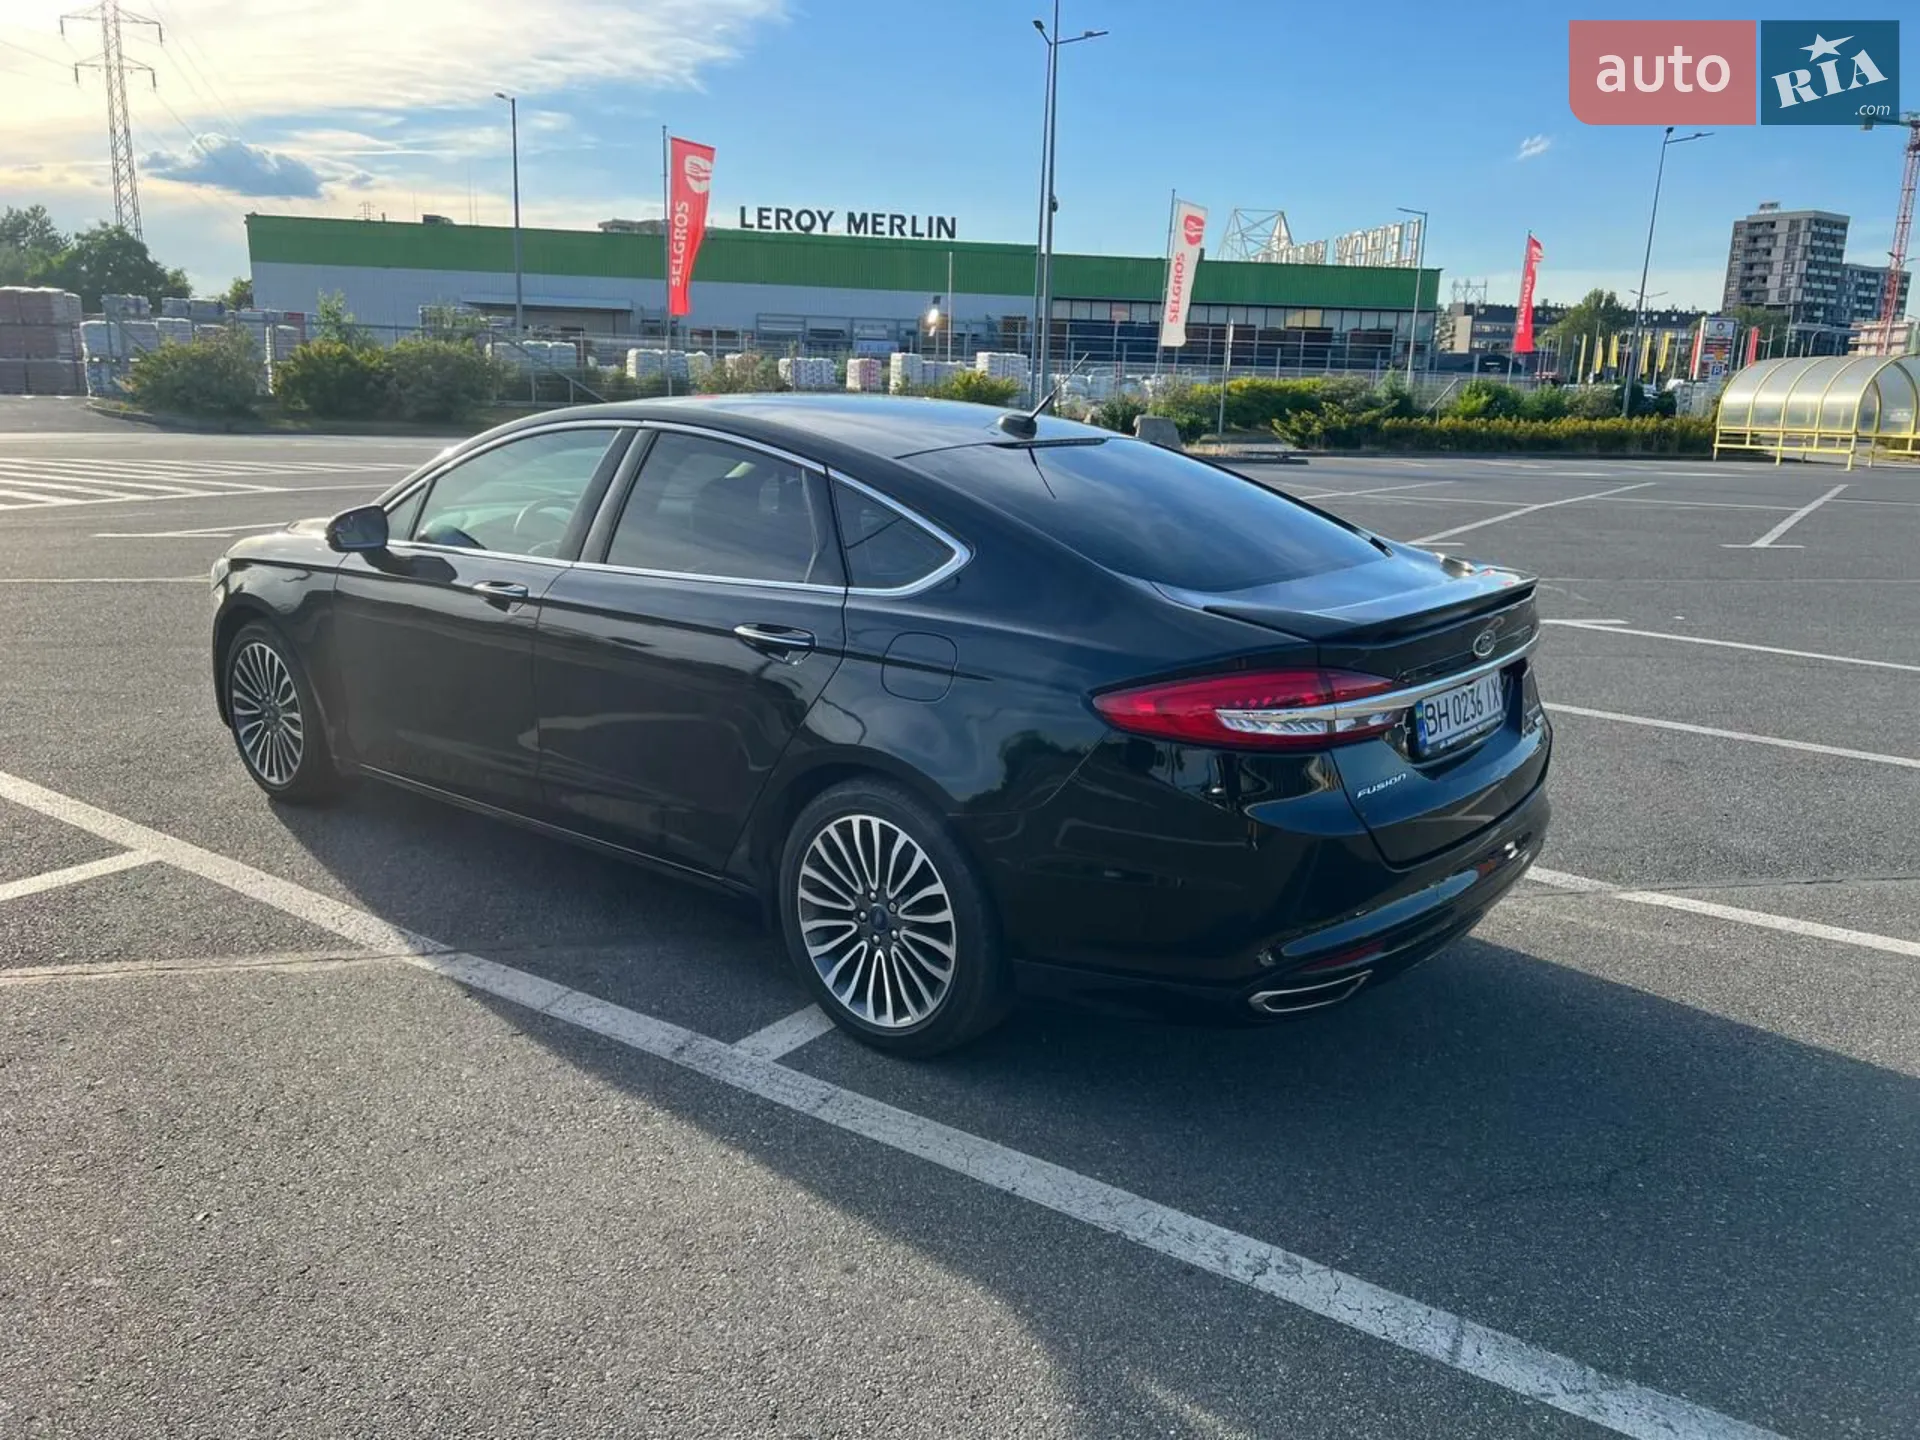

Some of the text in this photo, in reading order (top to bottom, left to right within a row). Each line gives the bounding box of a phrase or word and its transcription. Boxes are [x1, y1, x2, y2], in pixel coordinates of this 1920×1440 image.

[672, 201, 689, 287] SELGROS
[740, 205, 957, 239] LEROY MERLIN
[1168, 252, 1186, 325] SELGROS
[1425, 697, 1451, 737] BH
[1452, 686, 1484, 726] 0236
[1486, 676, 1501, 712] IX
[1356, 772, 1407, 799] FUSION
